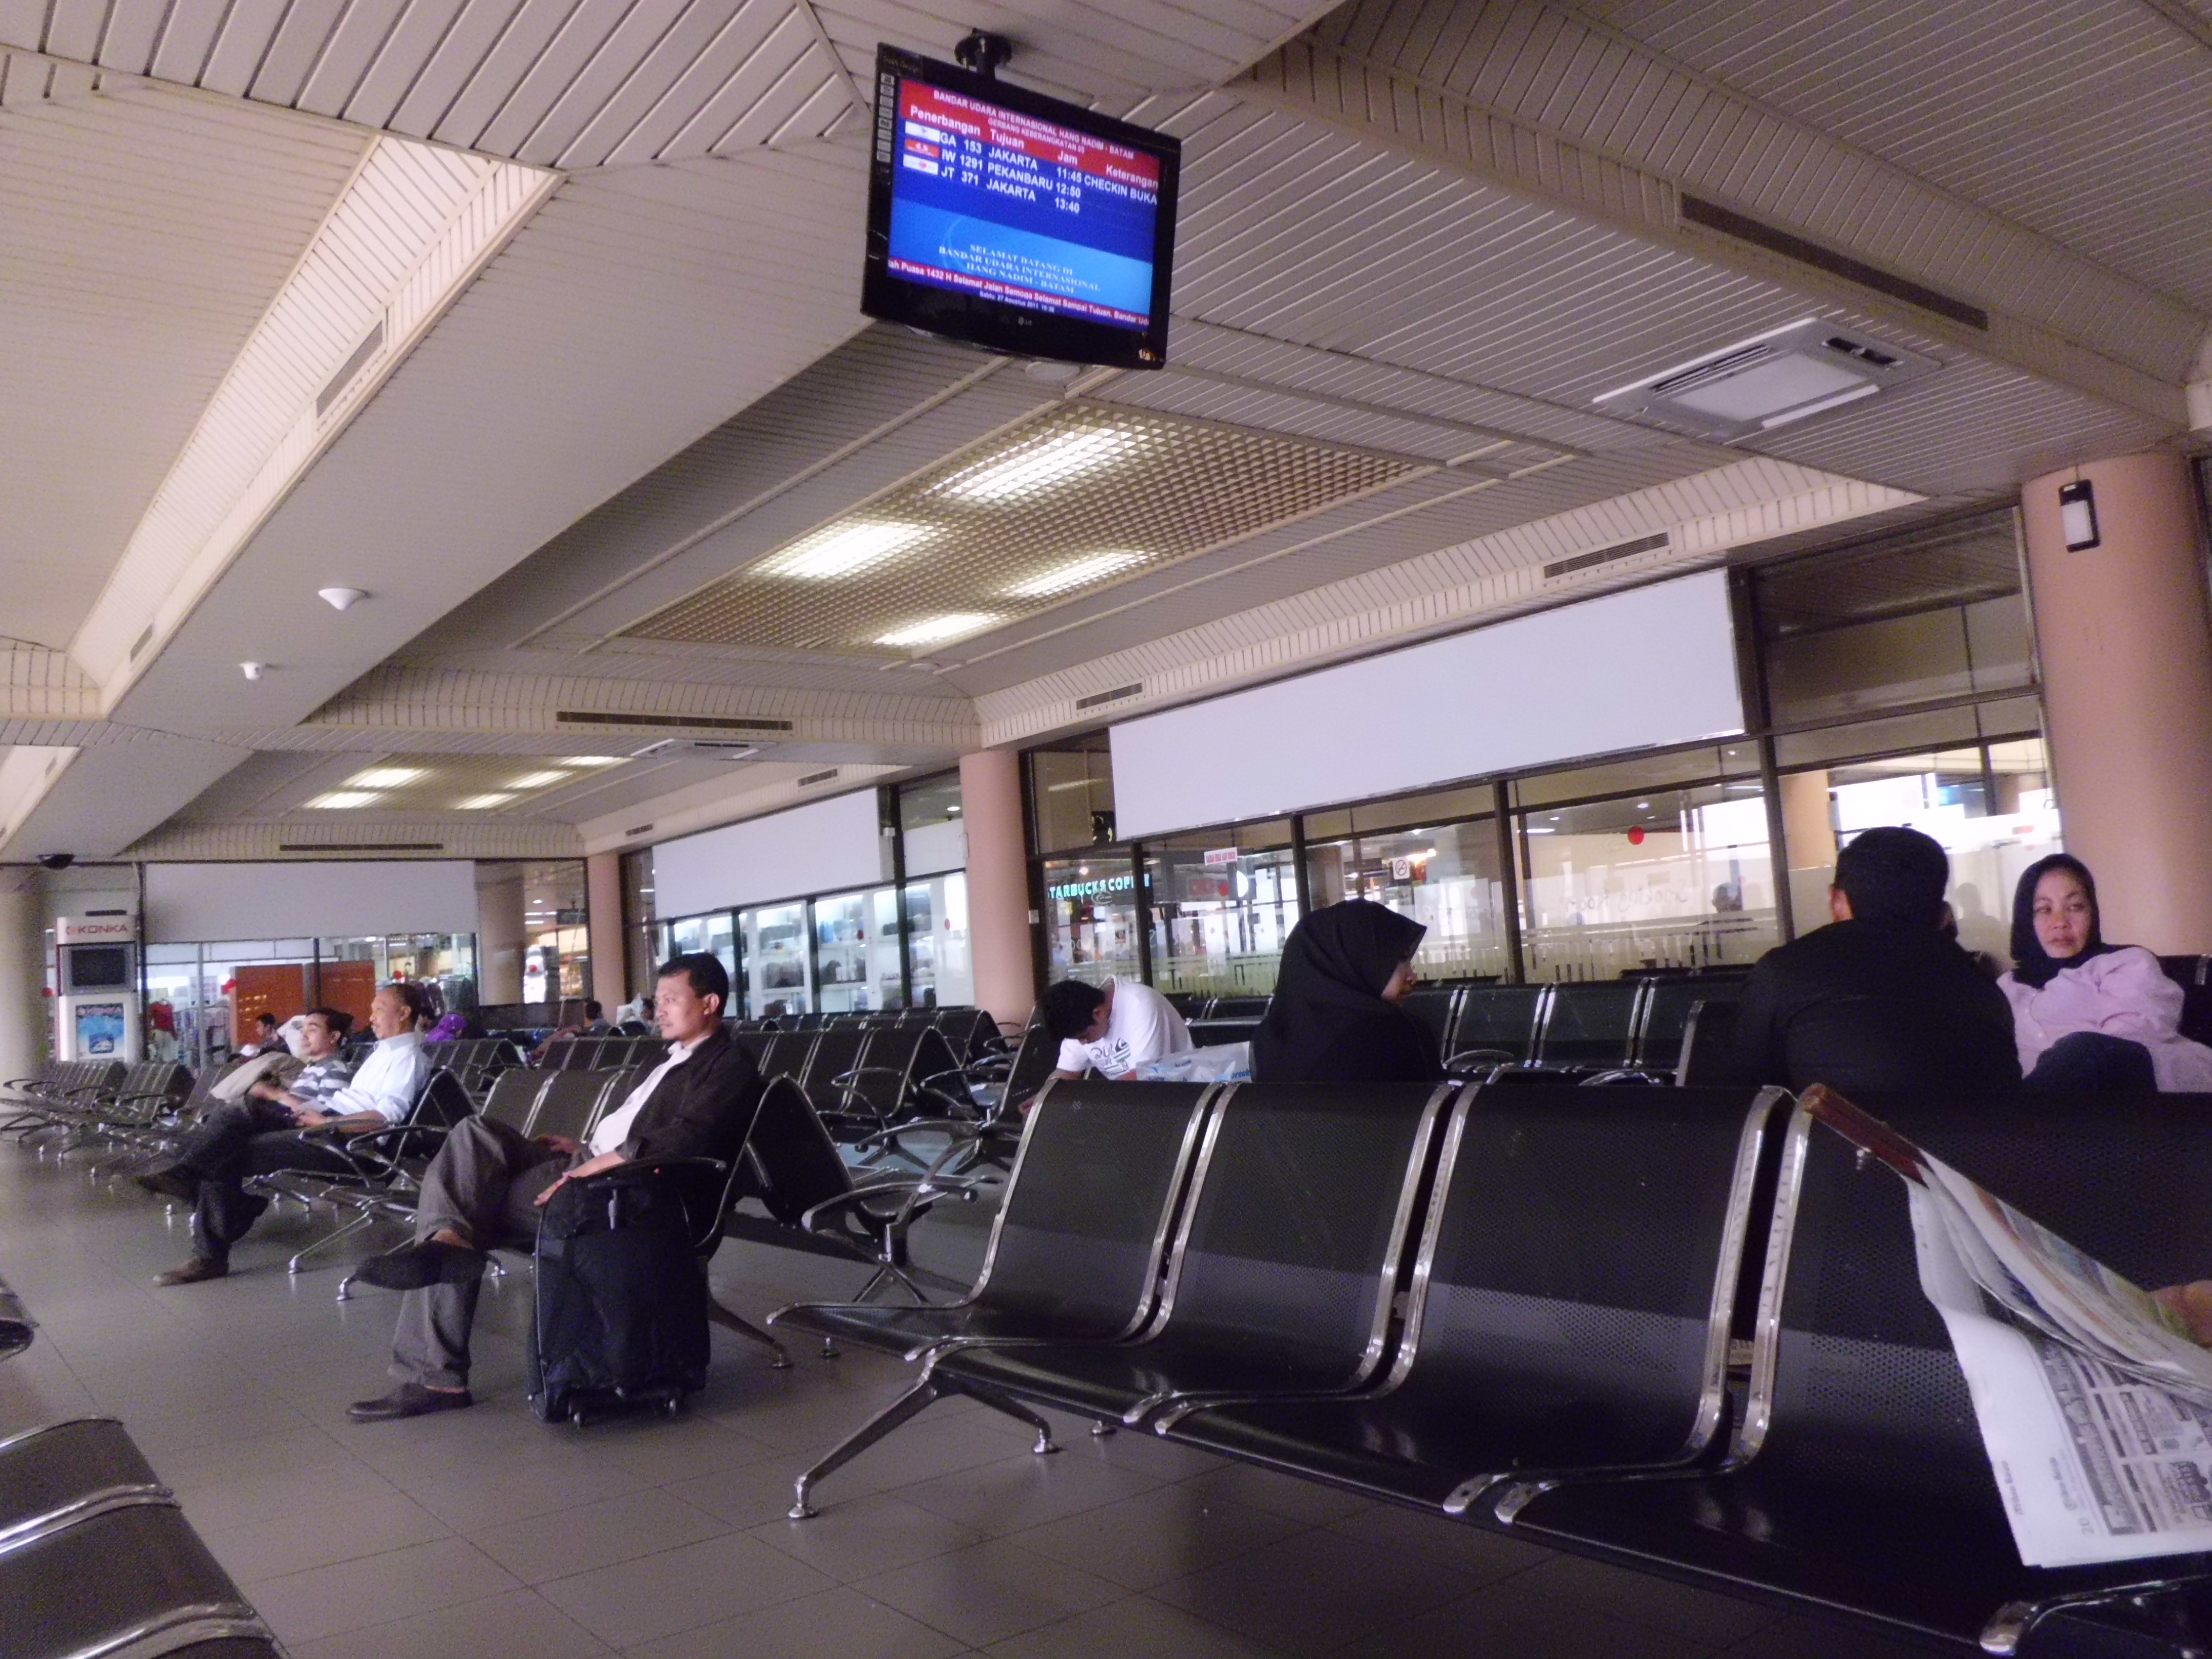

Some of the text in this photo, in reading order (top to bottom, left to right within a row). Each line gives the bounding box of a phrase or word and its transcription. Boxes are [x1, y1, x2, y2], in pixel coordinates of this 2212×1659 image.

[910, 104, 1159, 190] Penerbangan Tujuan Jam Keterangan
[933, 90, 968, 109] BANDAR
[970, 101, 996, 117] UDARA
[998, 110, 1057, 137] INTERNASIONAL
[1059, 129, 1079, 143] HANG
[1081, 136, 1104, 151] NADIM
[1110, 145, 1134, 160] BATAM
[988, 117, 1020, 134] GERBANG
[1021, 127, 1076, 151] KEBERANGKATAN
[940, 132, 1158, 205] GA 153 JAKARTA 11:45 CHECKIN BUKA
[941, 166, 1080, 214] JT 371 JAKARTA 13:40
[942, 148, 1081, 199] IW 1291 PEKANBARU 12:50
[939, 245, 1100, 291] BANDAR UDARA INTERNASIONAL
[967, 262, 996, 276] HANG
[999, 270, 1033, 285] NADIM
[1041, 280, 1074, 294] BATAM
[970, 244, 1073, 276] SELAMAT DATANG DI
[901, 261, 924, 276] Puasa
[927, 268, 944, 280] 1432
[946, 272, 952, 282] H
[953, 274, 983, 288] Selamat
[984, 281, 1003, 293] Jalan
[1005, 286, 1033, 300] Semoga
[1034, 292, 1061, 306] Selamat
[1062, 299, 1087, 312] Sampai
[1114, 310, 1137, 323] Bandar
[1047, 879, 1106, 899] TARBUCKS
[78, 924, 128, 934] KONKA
